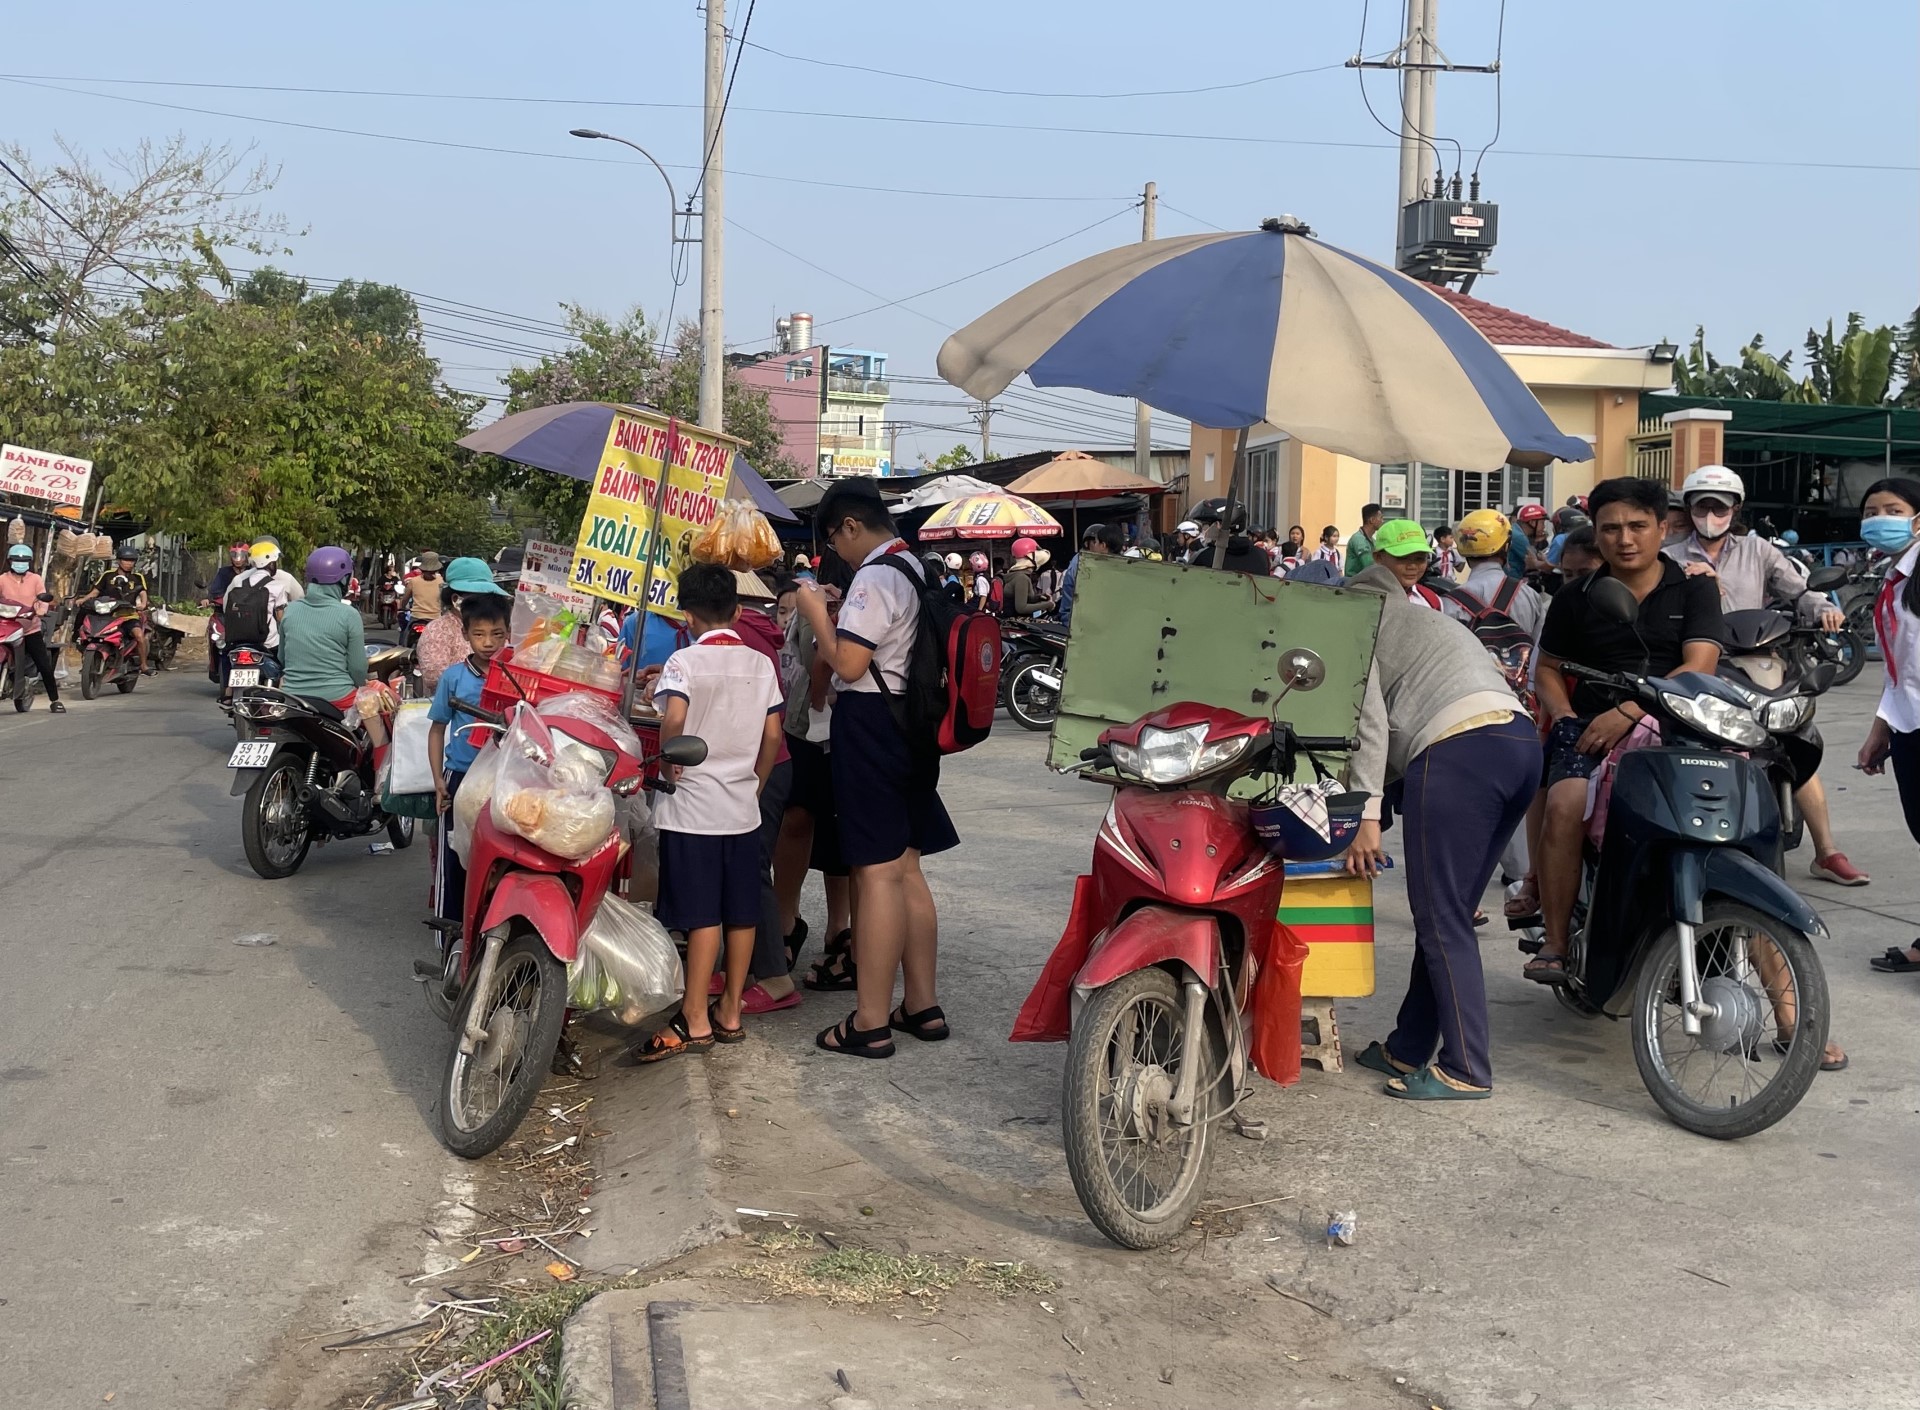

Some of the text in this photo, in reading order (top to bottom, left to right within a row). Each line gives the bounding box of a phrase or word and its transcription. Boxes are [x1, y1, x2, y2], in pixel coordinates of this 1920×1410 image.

[5, 452, 87, 475] BÁNH ỐNG
[614, 415, 730, 483] BÁNH TRNG TRỘN
[24, 485, 45, 497] 0989
[47, 490, 63, 501] 422
[65, 494, 81, 504] 850
[599, 462, 718, 526] BÁNH TRNG CUỐN
[586, 515, 637, 557] XOÀI
[576, 558, 596, 585] 5K
[606, 566, 633, 595] 10K
[648, 579, 671, 605] 5K
[1680, 758, 1729, 769] HONDA
[1178, 800, 1215, 811] HONDA
